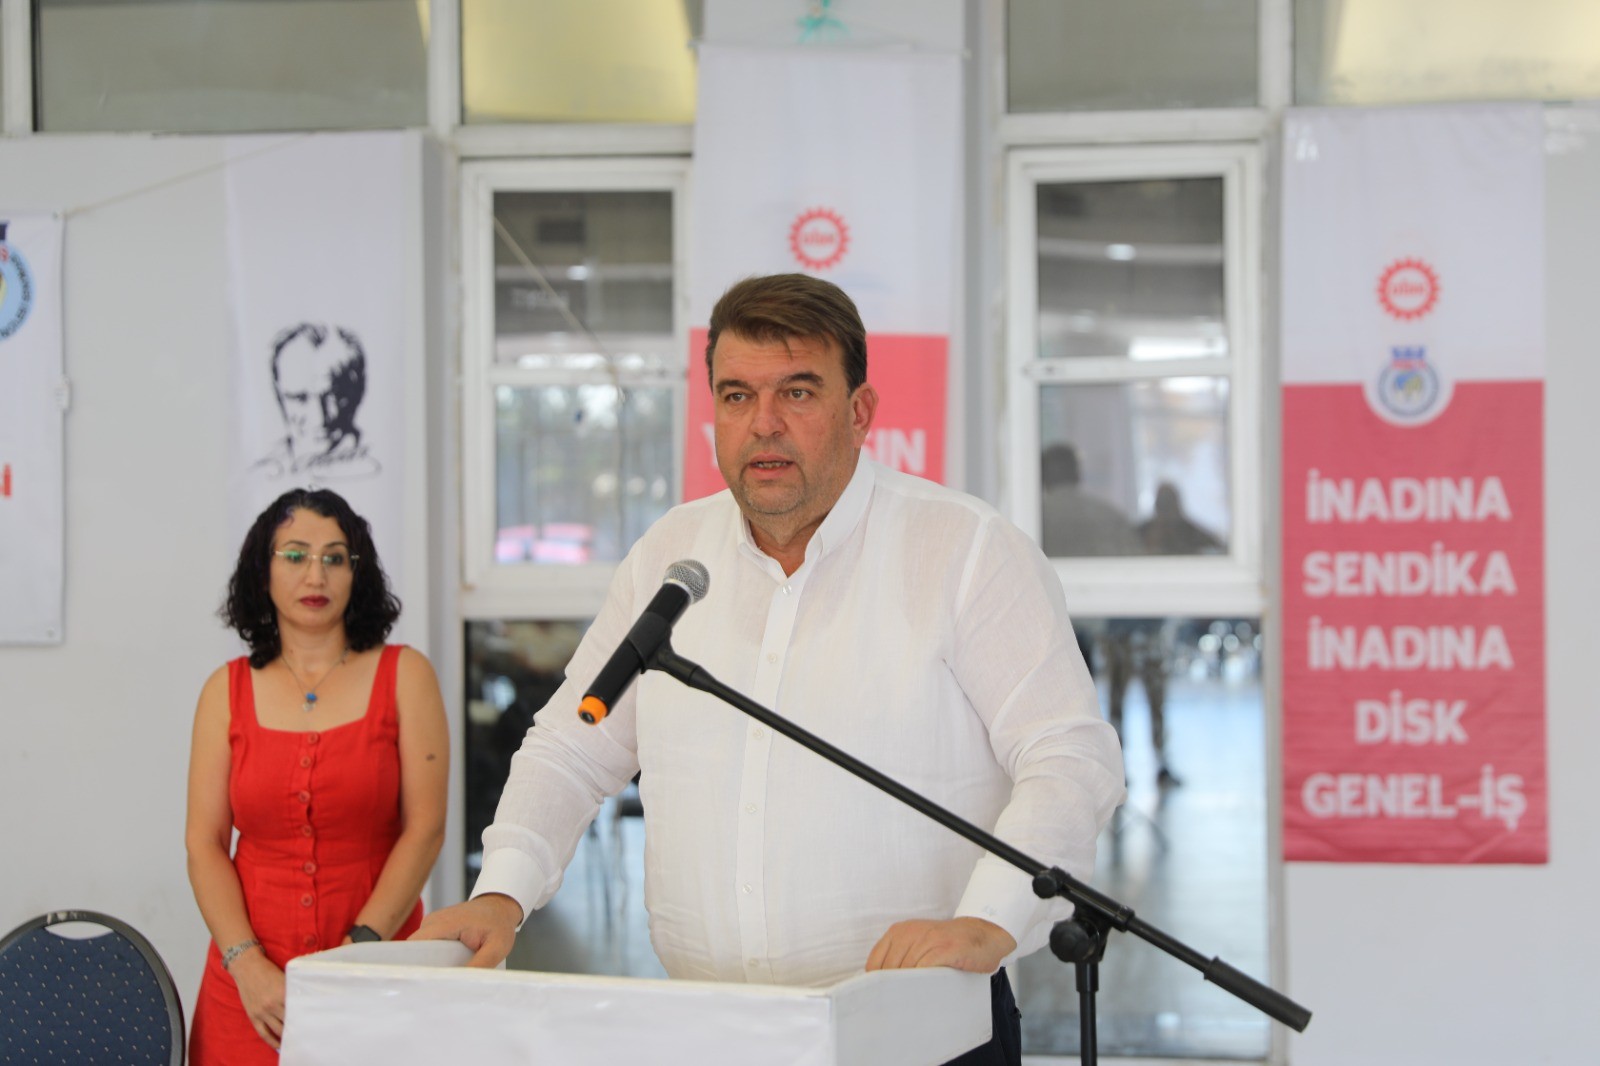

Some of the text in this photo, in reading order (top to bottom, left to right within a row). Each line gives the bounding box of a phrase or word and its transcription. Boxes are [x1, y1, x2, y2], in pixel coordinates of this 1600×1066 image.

[1306, 469, 1511, 522] İNADINA
[1303, 542, 1517, 597] SENDİKA
[1308, 616, 1514, 670] İNADINA
[1355, 690, 1468, 744] DİSK
[1303, 765, 1527, 831] GENEL-İŞ
